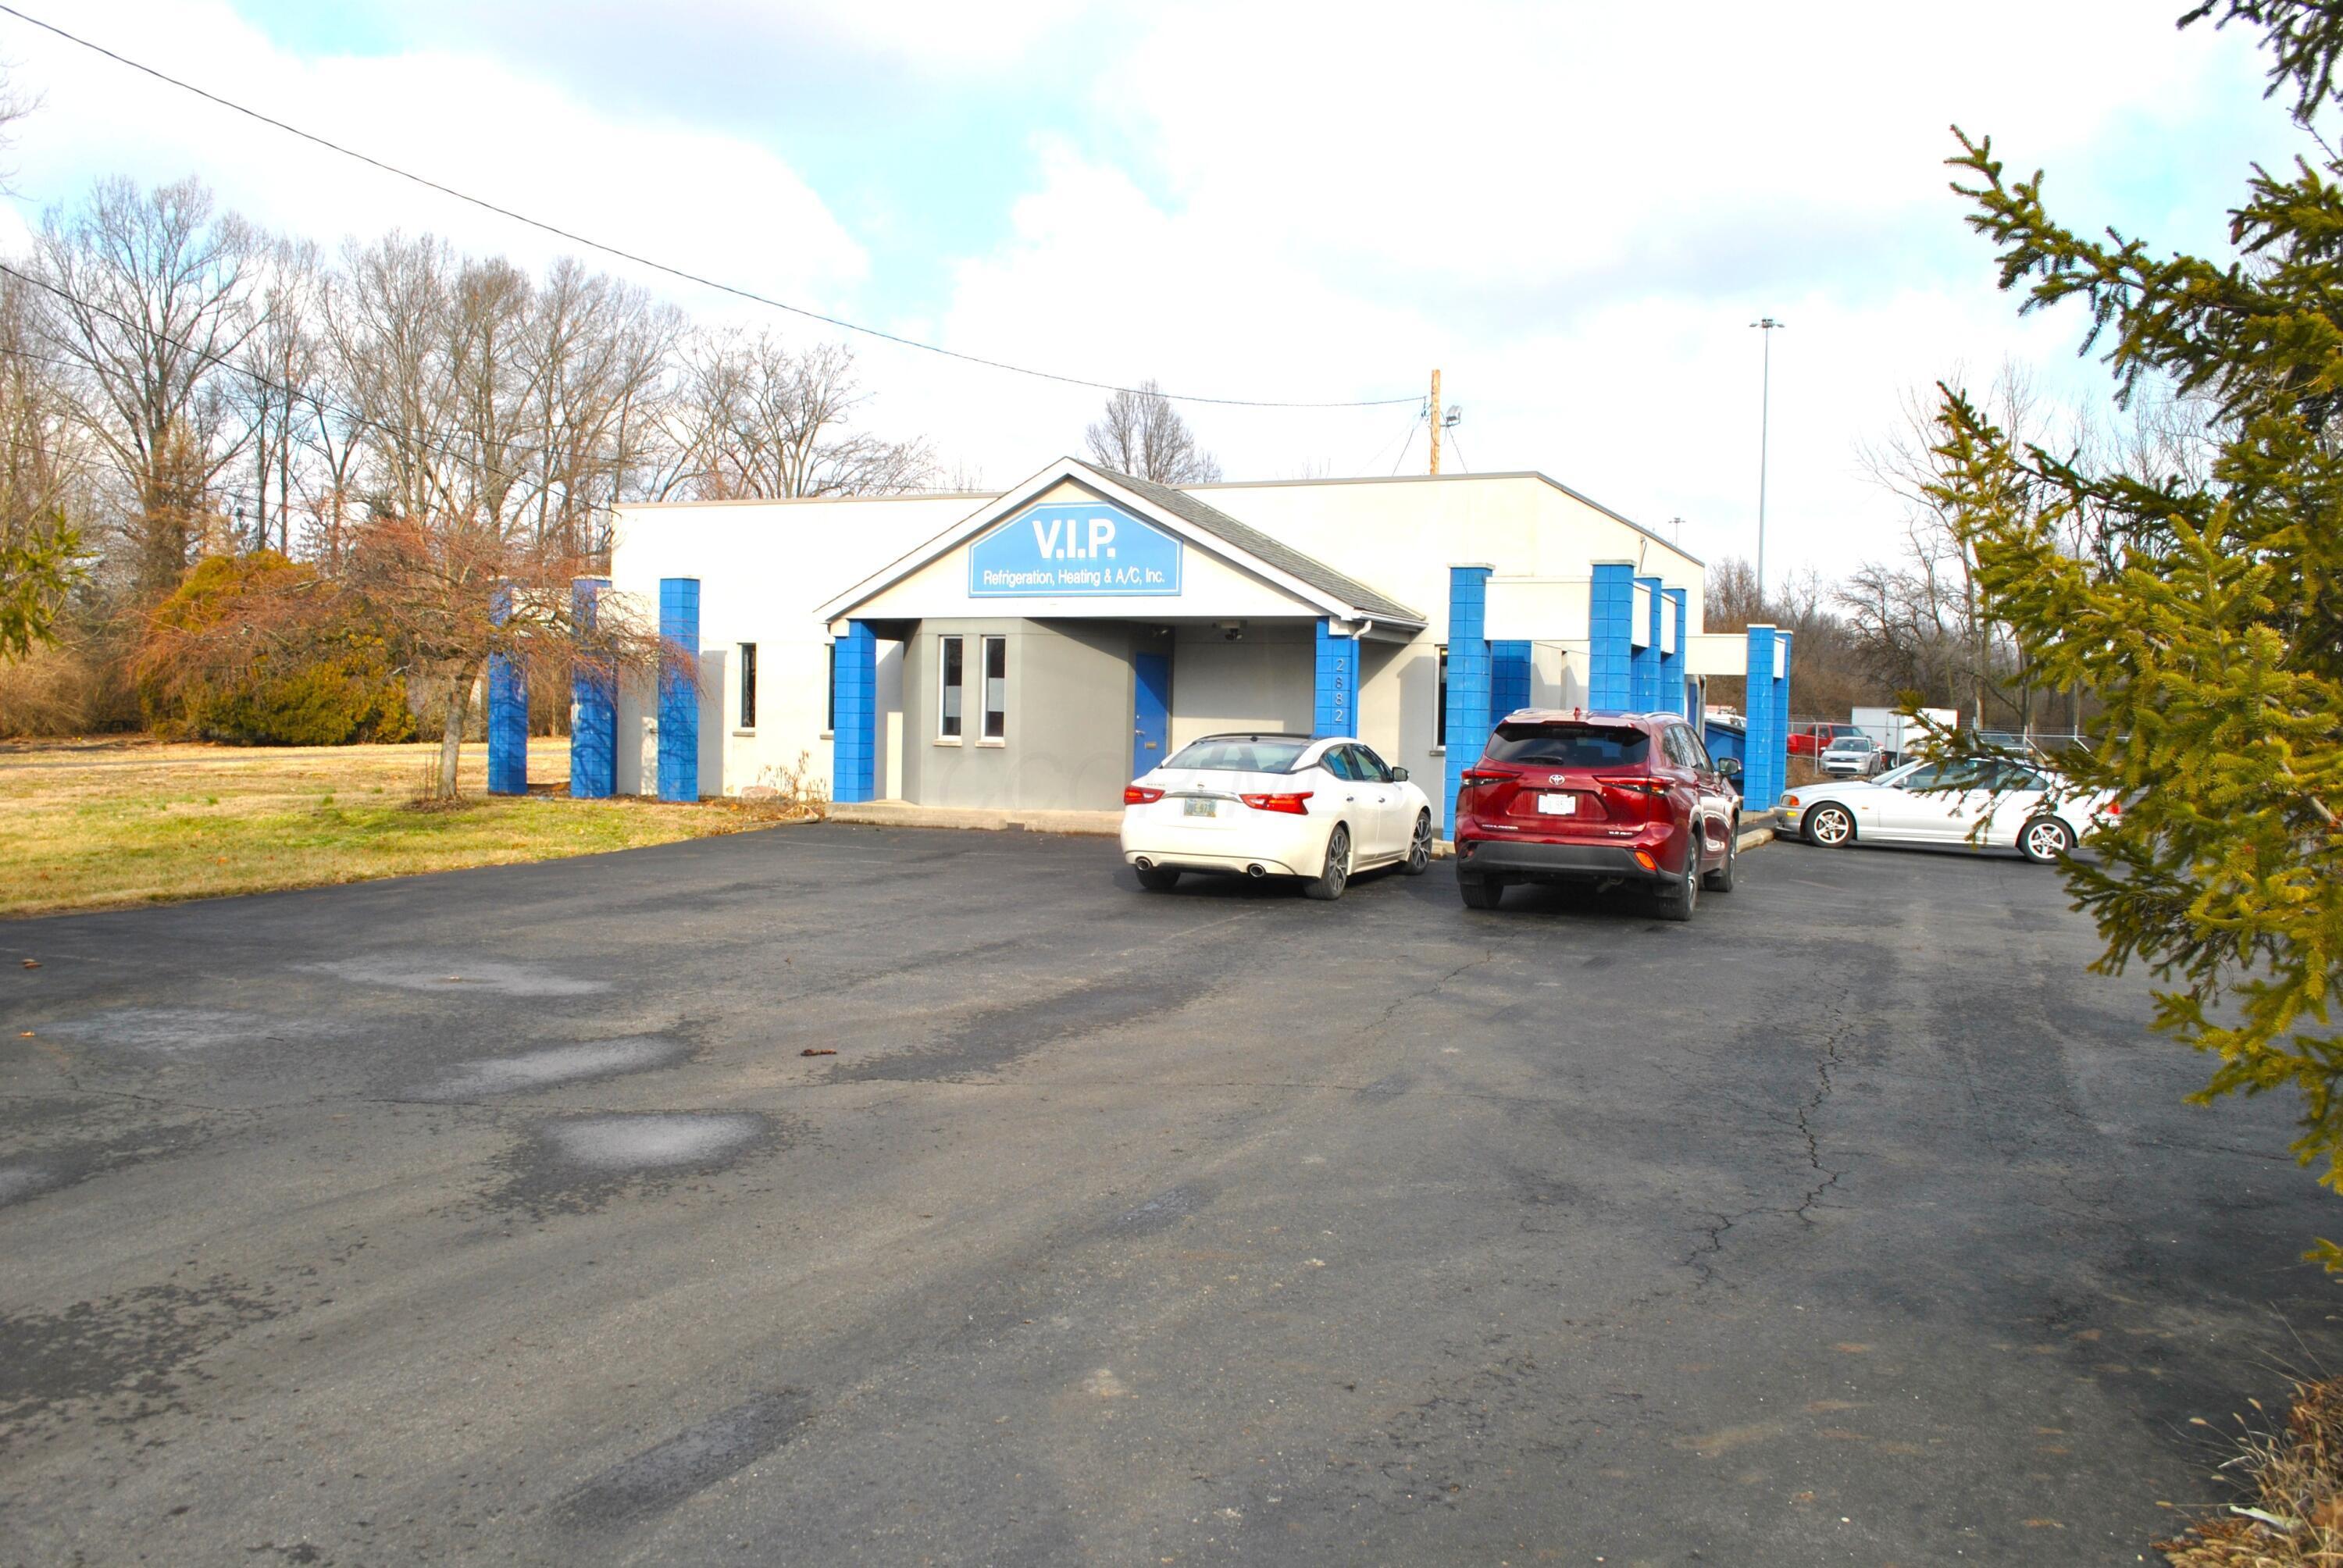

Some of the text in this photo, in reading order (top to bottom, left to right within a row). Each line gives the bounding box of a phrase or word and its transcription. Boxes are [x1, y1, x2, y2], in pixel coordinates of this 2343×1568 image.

[1032, 518, 1116, 560] V.I.P.
[983, 565, 1165, 588] Refrigeration, Heating & A/C, Inc.
